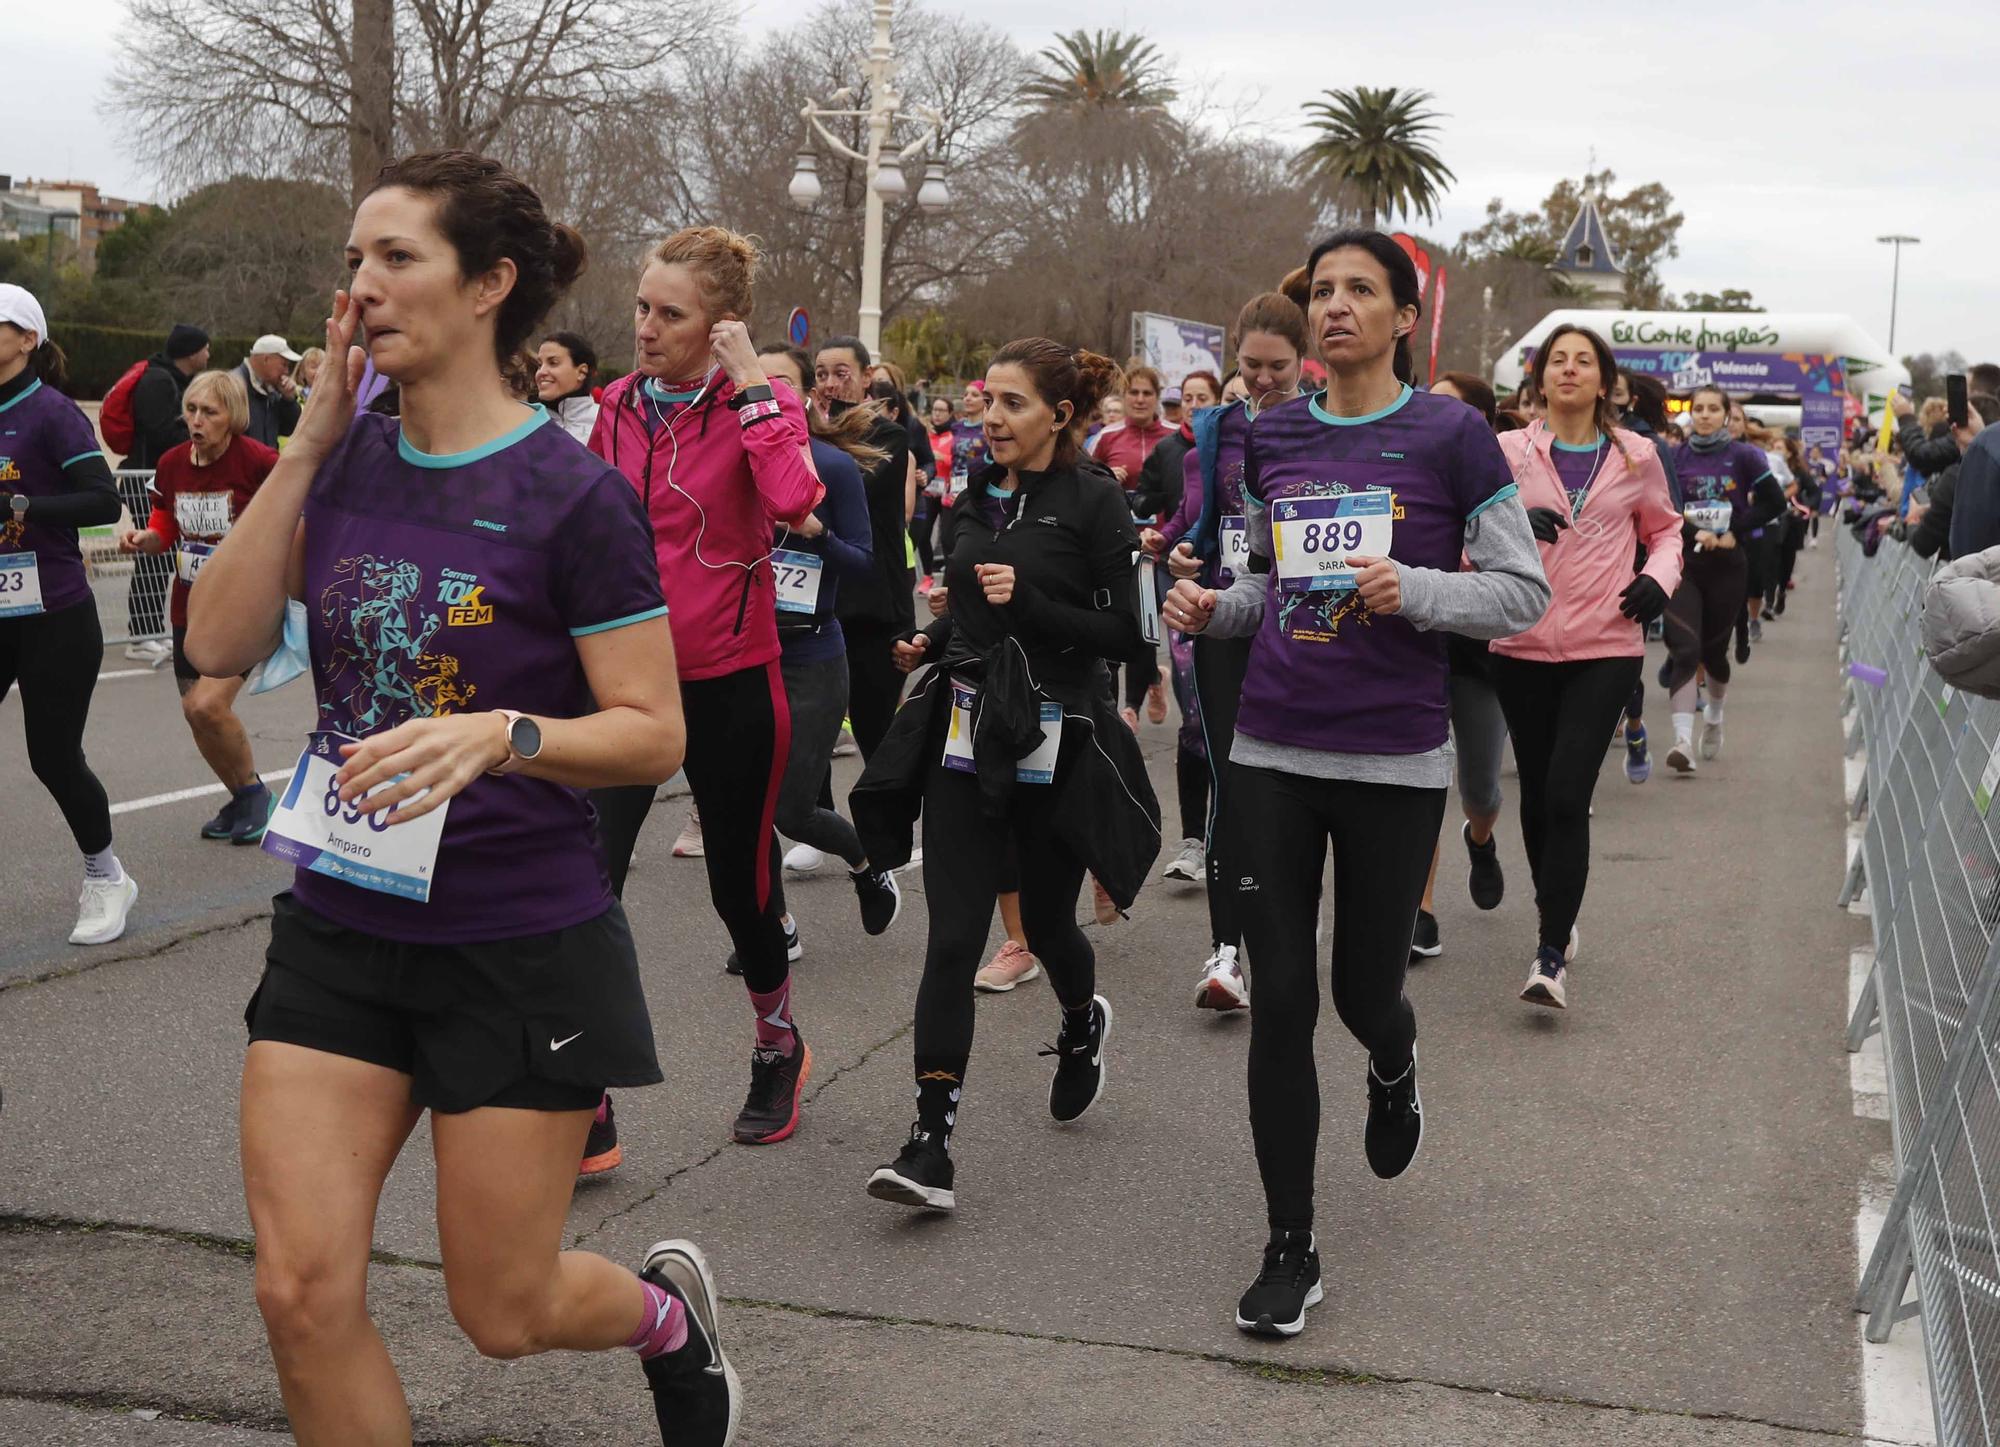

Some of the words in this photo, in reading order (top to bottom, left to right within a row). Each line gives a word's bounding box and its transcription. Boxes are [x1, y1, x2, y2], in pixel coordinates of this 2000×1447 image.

[1612, 320, 1634, 343] El
[1637, 321, 1692, 344] Corte
[1695, 318, 1779, 352] Inglés
[1712, 360, 1769, 376] Valencia
[181, 501, 220, 512] CALLE
[183, 519, 227, 531] LAUREL
[1303, 521, 1362, 553] 889
[1319, 561, 1345, 570] SARA
[437, 580, 485, 607] 10K
[451, 608, 490, 624] FEM
[327, 832, 372, 858] Amparo
